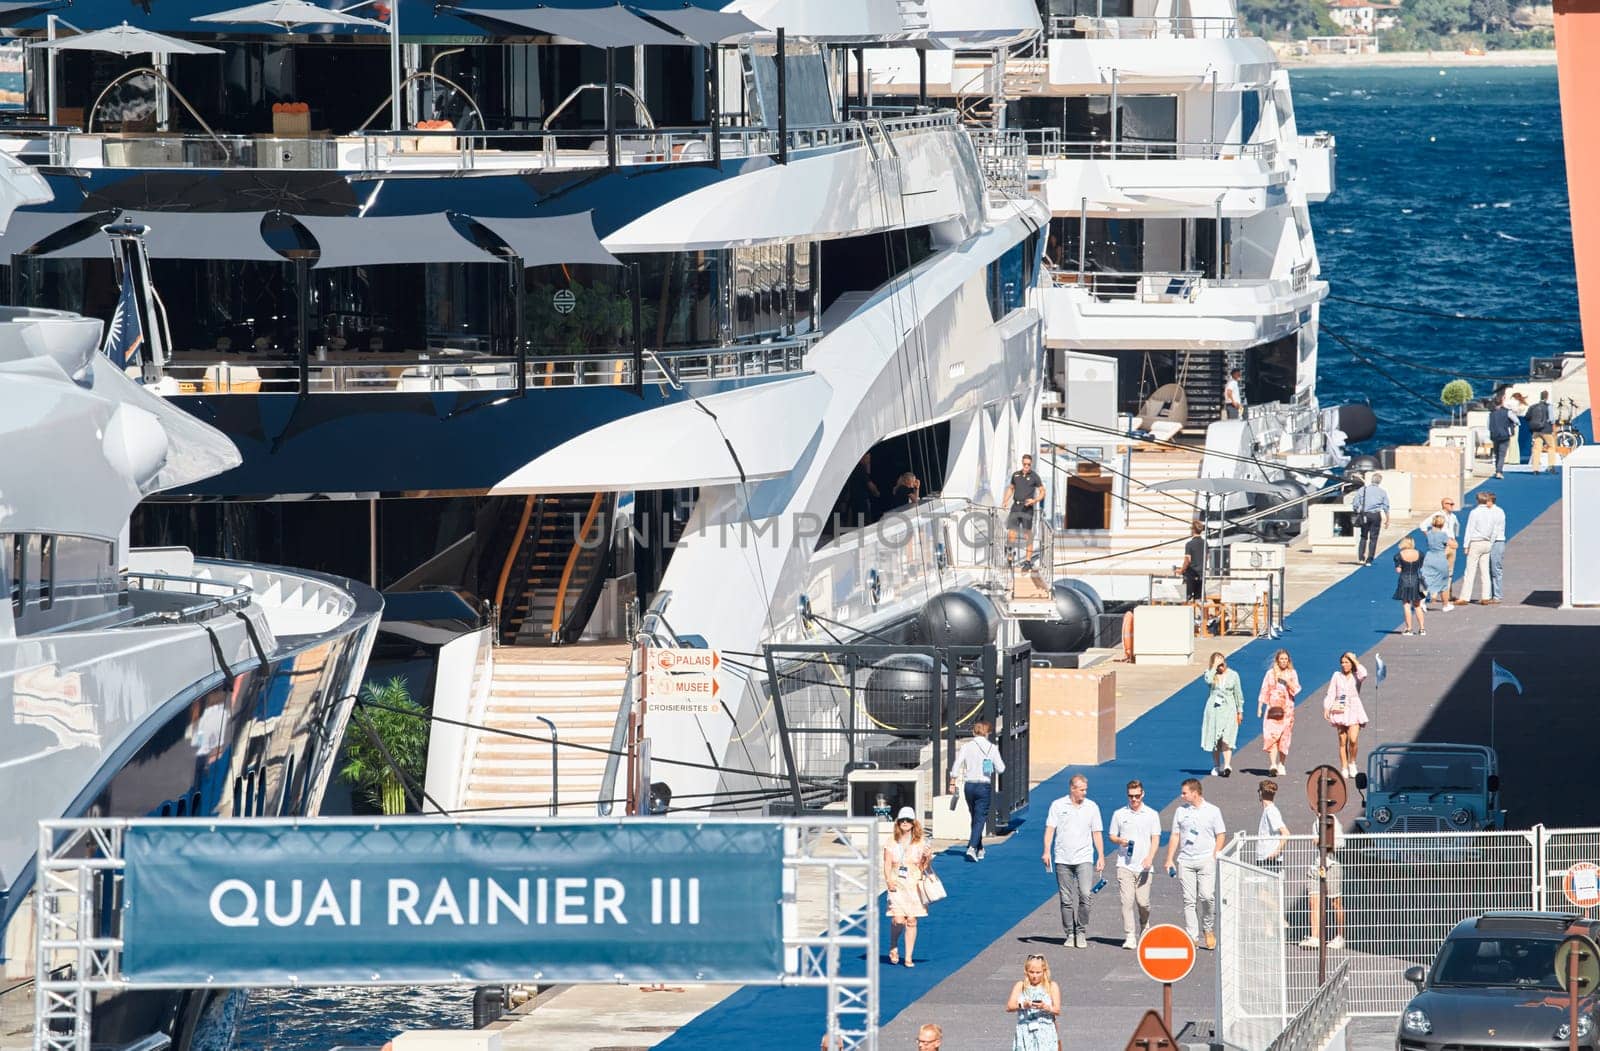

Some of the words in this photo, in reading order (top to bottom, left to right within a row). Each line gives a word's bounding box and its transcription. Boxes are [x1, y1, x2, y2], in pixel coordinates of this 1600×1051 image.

[676, 655, 711, 666] PALAIS
[675, 682, 710, 692] MUSEE
[648, 704, 709, 712] CROISIERISTES
[208, 878, 361, 927] QUAI
[388, 878, 628, 925] RAINIER
[651, 878, 699, 924] III
